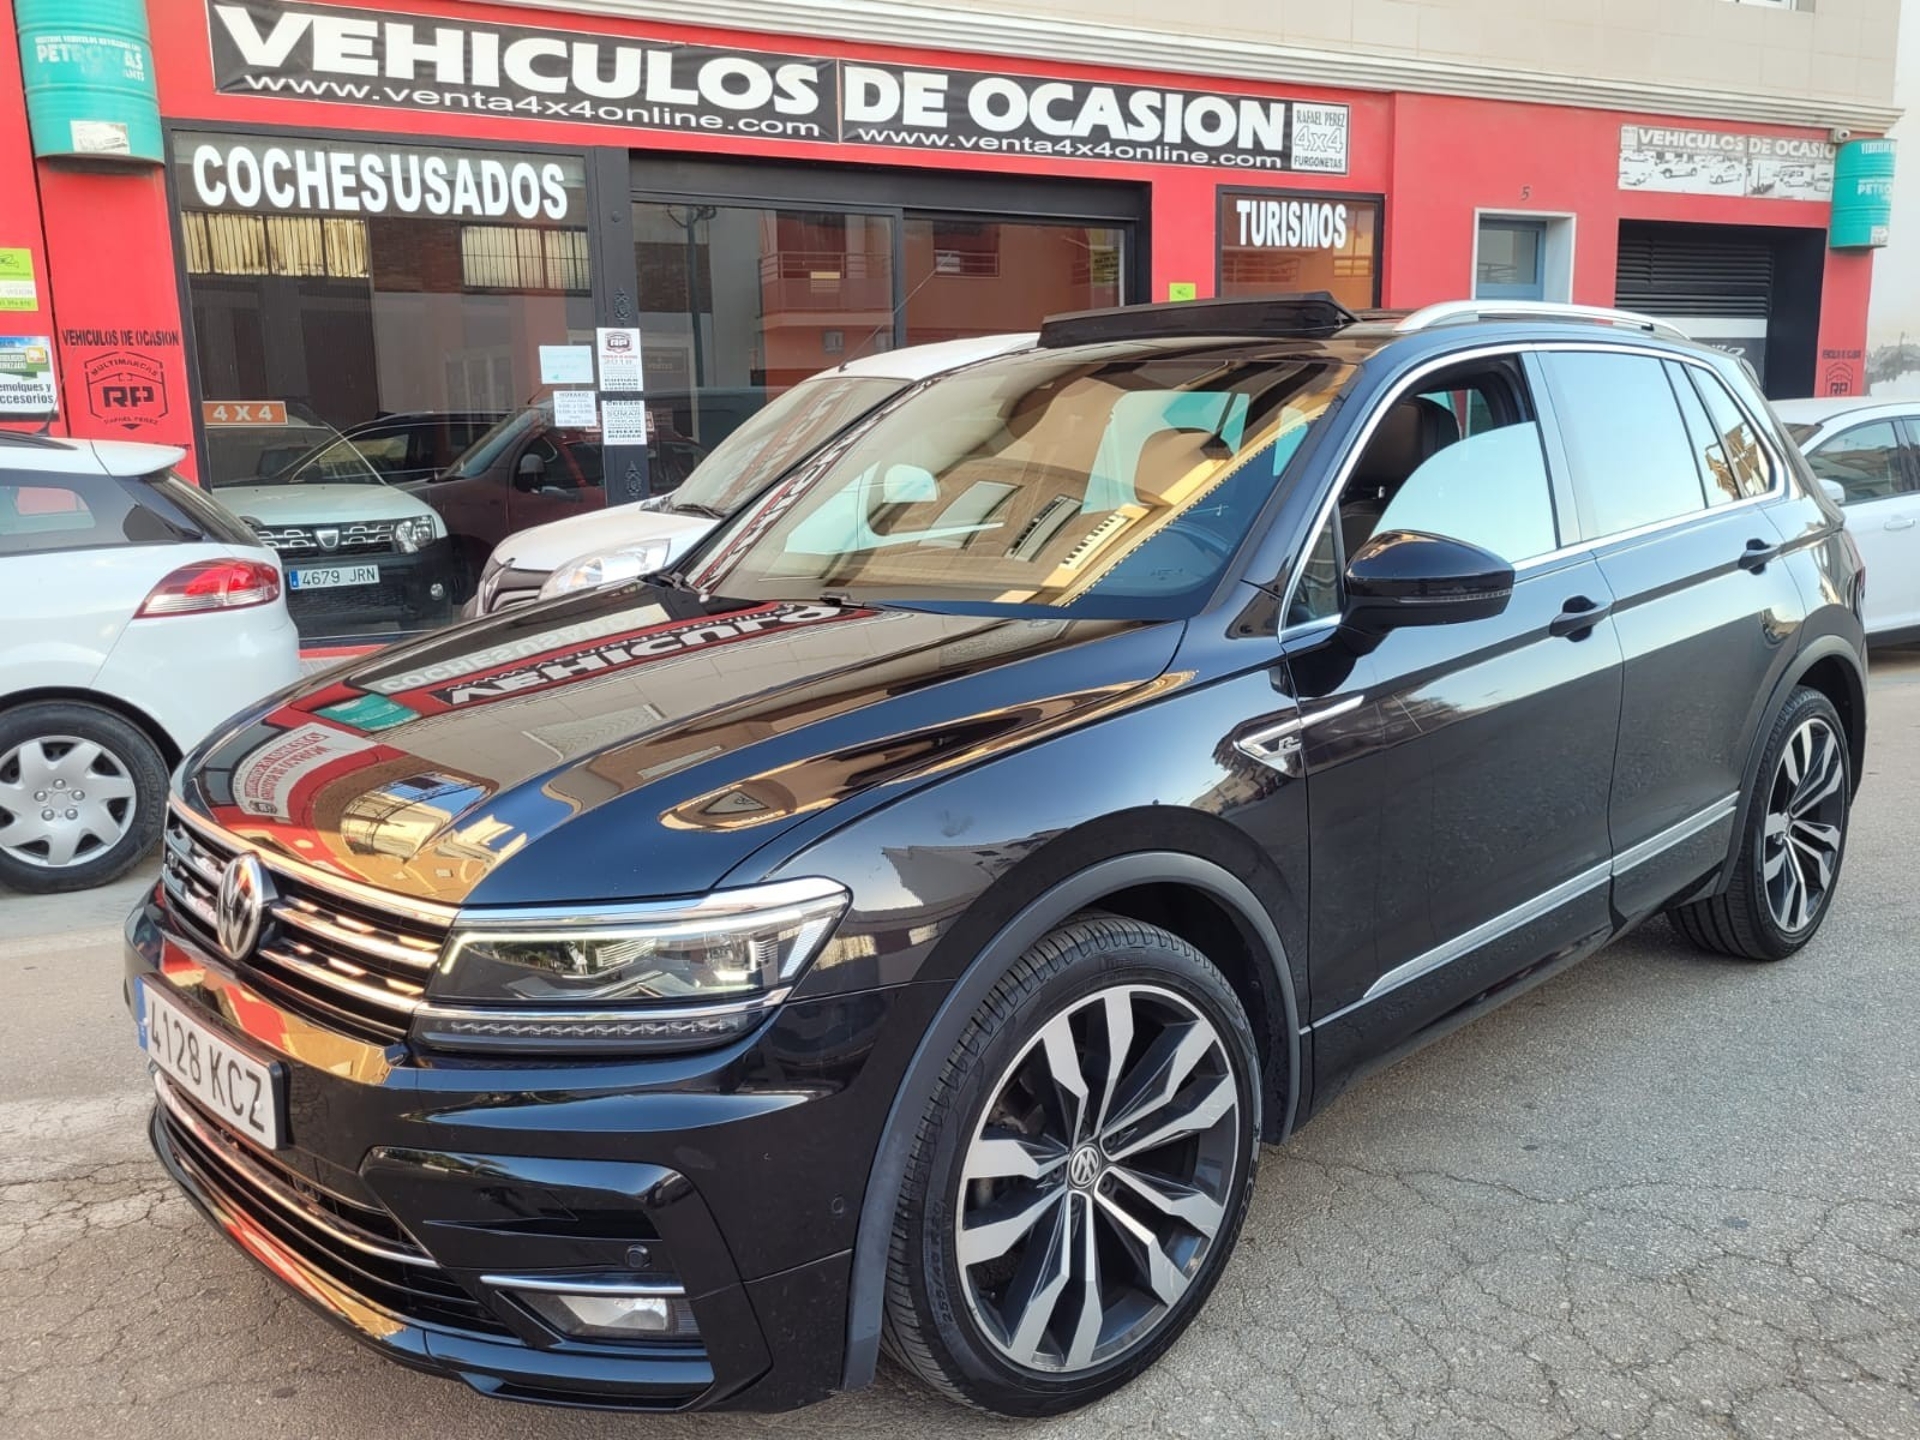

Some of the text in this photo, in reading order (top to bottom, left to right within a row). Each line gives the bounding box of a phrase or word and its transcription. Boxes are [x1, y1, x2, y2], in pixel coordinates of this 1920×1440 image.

[36, 44, 142, 70] PETROAS
[214, 4, 1285, 151] VEHICULOS DE OCASION
[245, 75, 820, 137] www.venta4x4online.com
[1297, 109, 1345, 127] RAFAEL PEREZ
[858, 128, 1281, 169] www.venta4x4online.com
[1295, 125, 1343, 153] 4x4
[1639, 129, 1744, 152] VEHICULOS
[1750, 137, 1771, 154] DE
[1294, 155, 1343, 169] FURGONETAS
[193, 145, 568, 219] COCHESUSADOS
[1520, 187, 1530, 200] 5
[1236, 200, 1347, 249] TURISMOS
[62, 329, 180, 347] VEHICULOS DE OCASION
[102, 386, 154, 408] RP
[302, 567, 376, 586] 4679 JRN
[150, 1002, 266, 1134] 4128 KCZ
